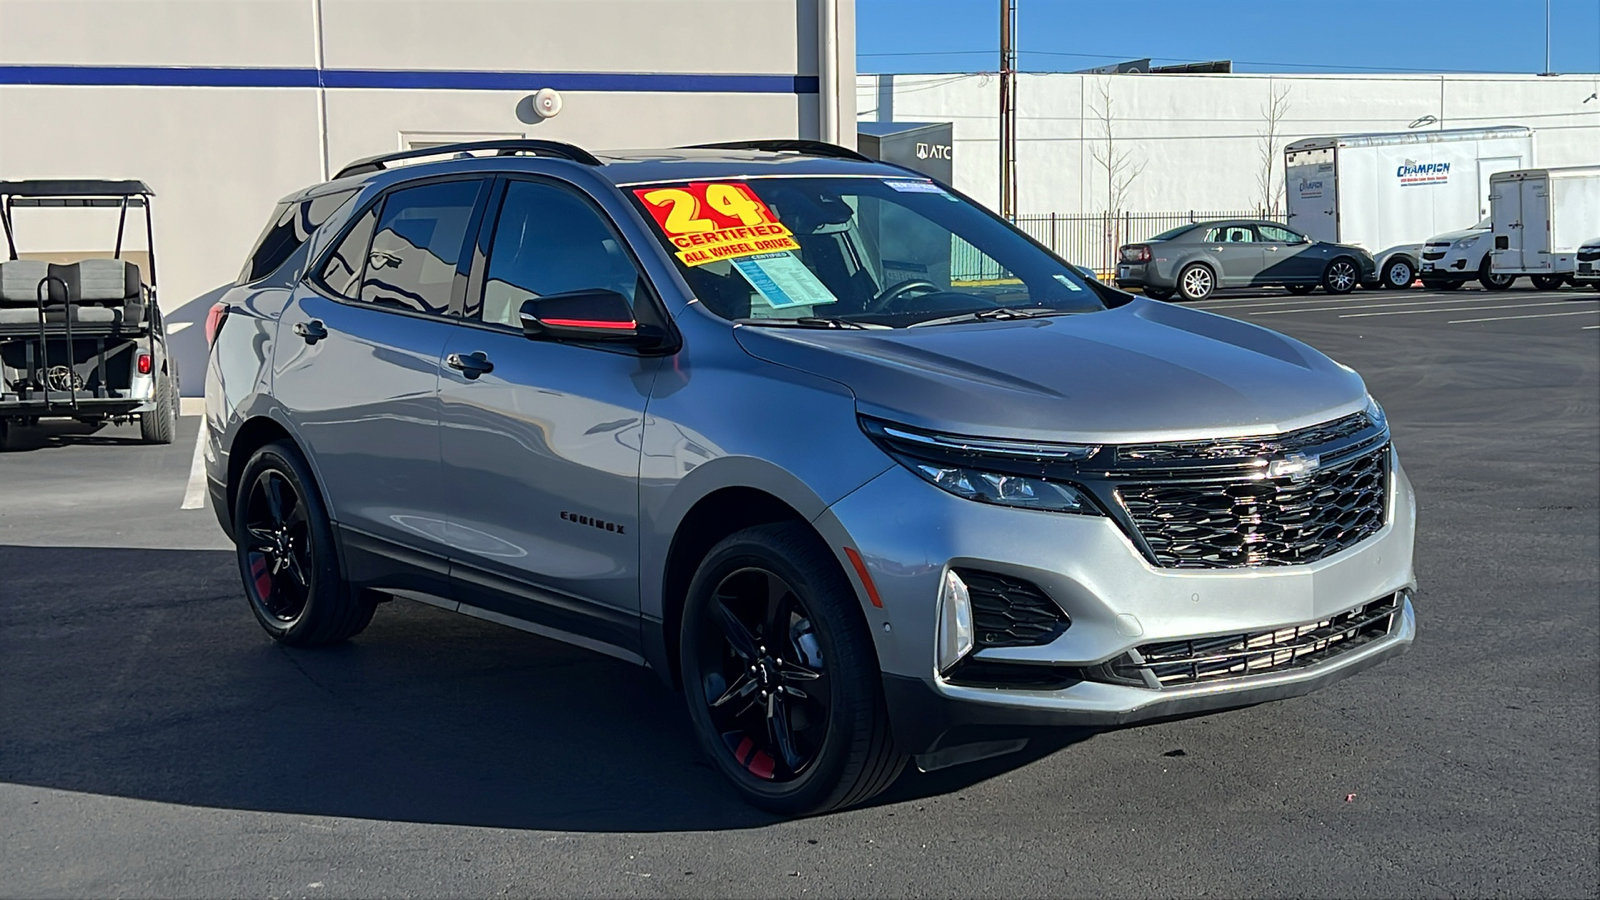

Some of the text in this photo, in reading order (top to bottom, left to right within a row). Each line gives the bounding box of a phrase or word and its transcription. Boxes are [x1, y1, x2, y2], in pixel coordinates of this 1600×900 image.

[930, 145, 951, 160] ATC
[1397, 163, 1450, 177] CHAMPION
[644, 184, 765, 234] 24
[674, 225, 783, 248] CERTIFIED
[684, 238, 792, 263] ALL WHEEL DRIVE
[560, 511, 625, 534] EQUINOX
